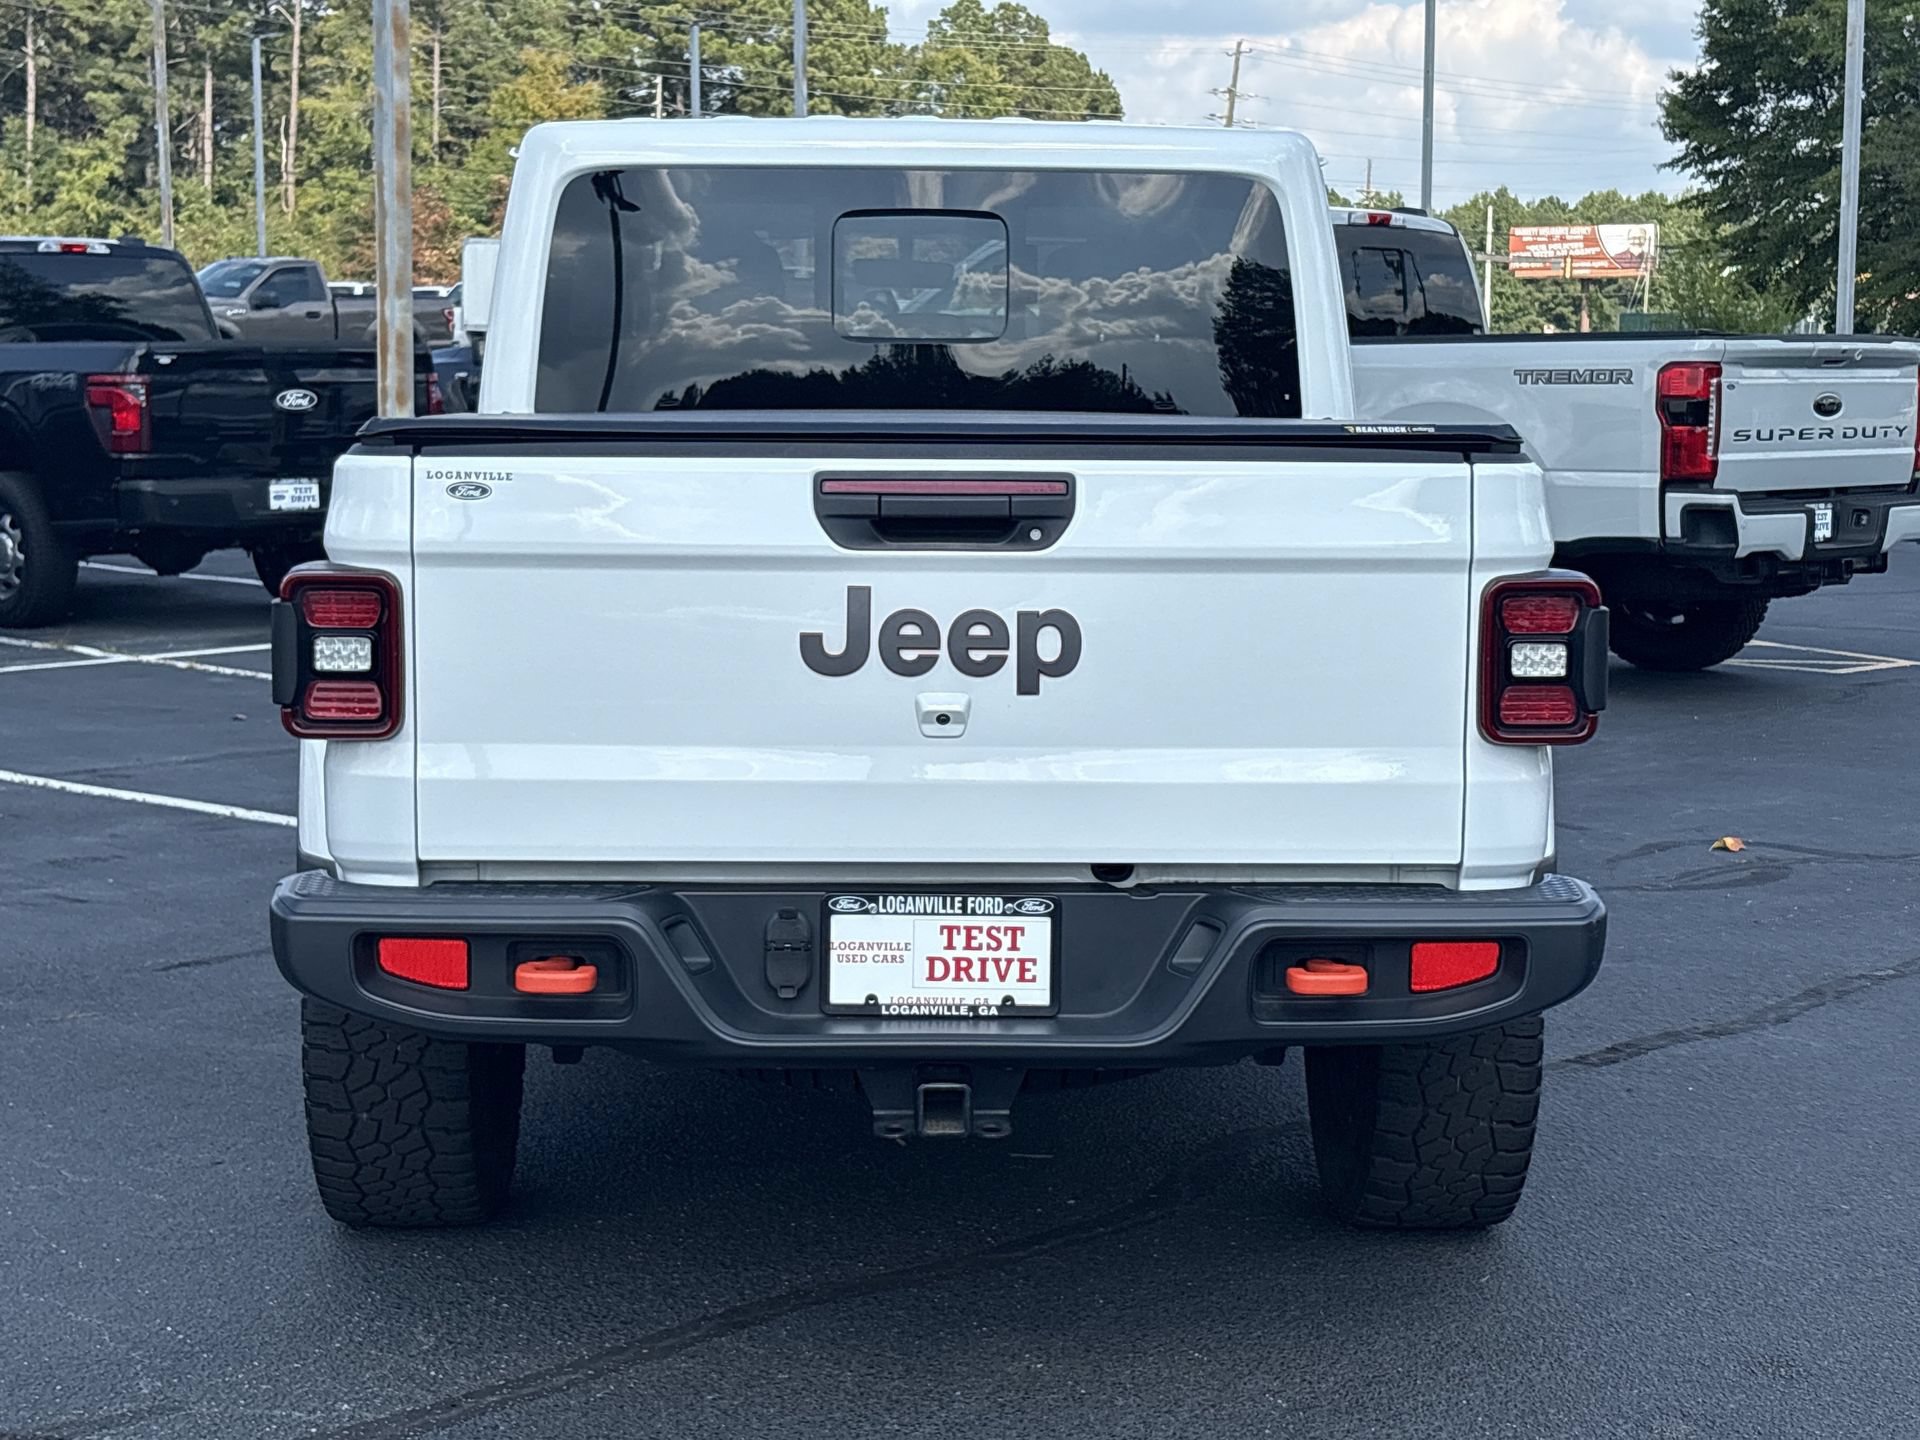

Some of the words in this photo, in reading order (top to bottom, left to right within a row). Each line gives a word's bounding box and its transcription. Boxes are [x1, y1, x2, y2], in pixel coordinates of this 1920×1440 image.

[1513, 368, 1634, 385] TREMOR
[1732, 427, 1835, 442] SUPER
[1842, 425, 1908, 439] DUTY
[426, 470, 513, 481] LOGANVILLE
[293, 486, 313, 494] TEST
[290, 494, 317, 503] DRIVE
[799, 585, 1082, 696] Jeep
[878, 895, 963, 914] LOGANVILLE
[967, 896, 1004, 915] FORD
[939, 924, 1026, 952] TEST
[830, 941, 912, 952] LOGANVILLE
[837, 954, 868, 963] USED
[872, 954, 905, 964] CARS
[925, 956, 1038, 983] DRIVE
[973, 997, 990, 1005] GA
[881, 1005, 973, 1017] LOGANVILLE,
[978, 1005, 999, 1016] GA
